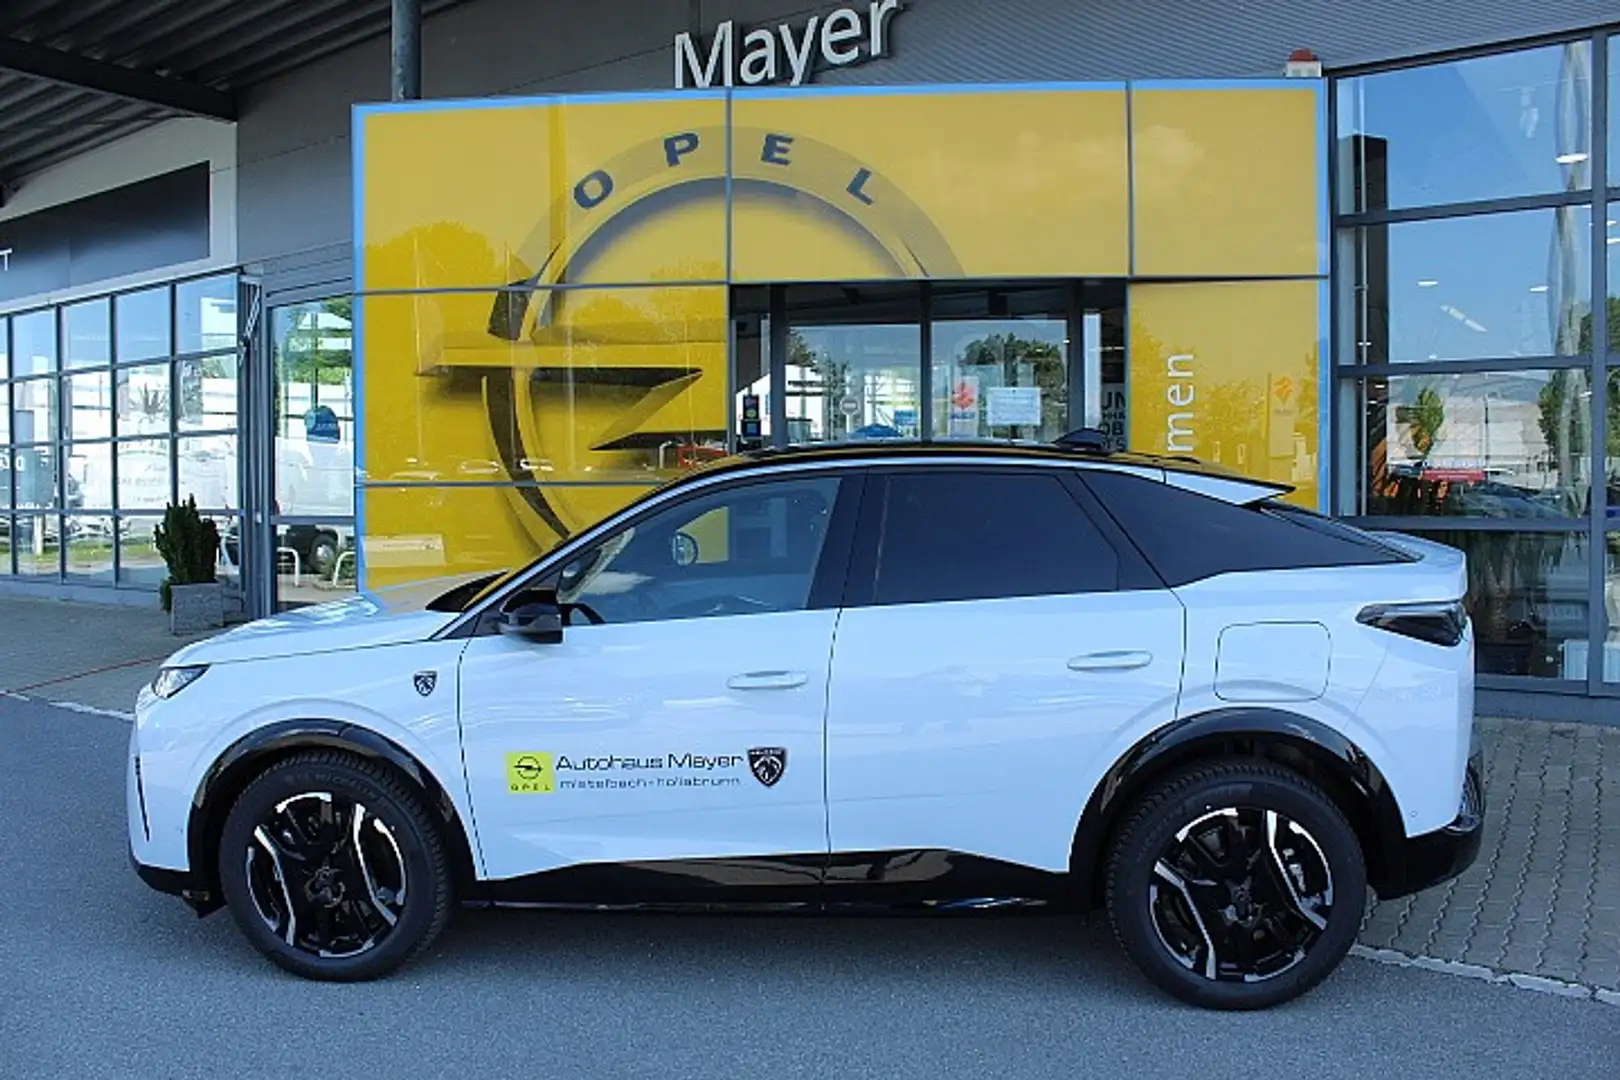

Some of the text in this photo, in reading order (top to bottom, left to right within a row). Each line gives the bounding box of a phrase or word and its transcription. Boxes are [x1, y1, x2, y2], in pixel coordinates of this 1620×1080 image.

[673, 0, 897, 89] Mayer
[573, 132, 874, 210] OPEL
[556, 752, 744, 771] Autohaus Mayer
